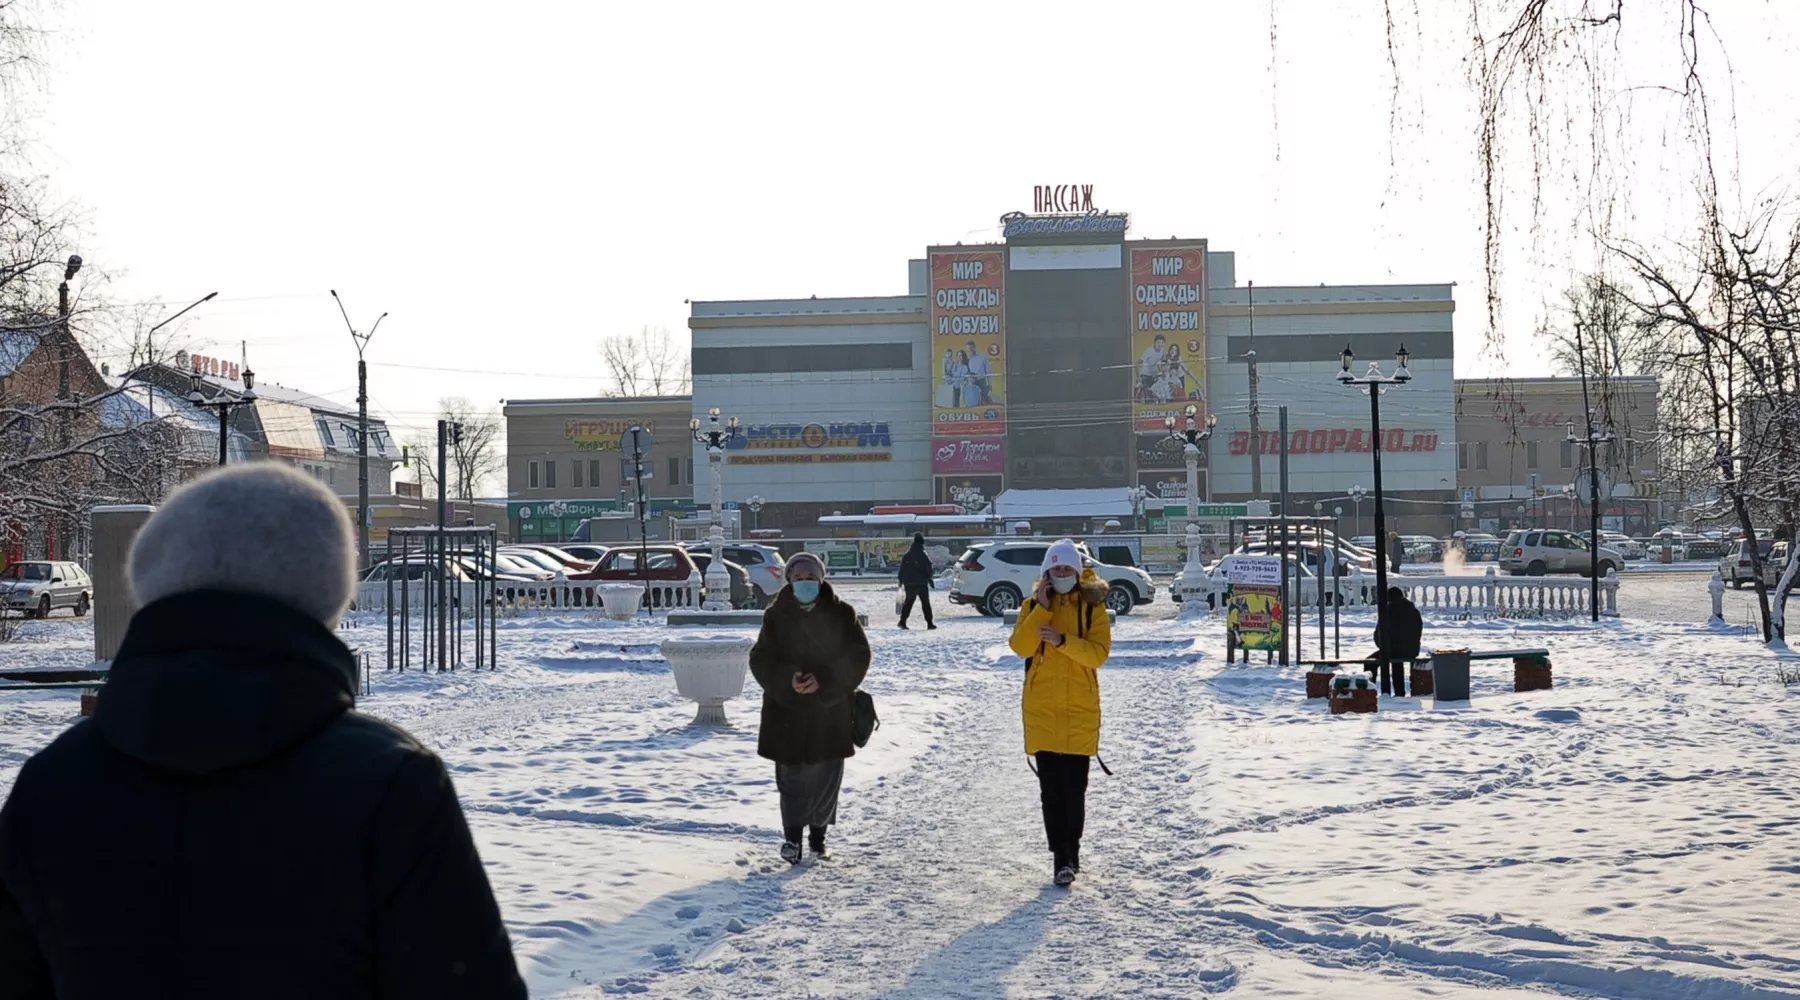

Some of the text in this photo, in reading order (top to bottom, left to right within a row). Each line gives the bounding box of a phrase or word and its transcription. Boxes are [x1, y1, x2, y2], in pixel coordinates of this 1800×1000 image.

[1034, 184, 1093, 212] ПАССАЖ
[1000, 208, 1130, 237] Васильевский
[952, 261, 984, 280] МИР
[1151, 257, 1183, 276] МИР
[936, 288, 1000, 310] ОДЕЖДЫ
[1135, 284, 1200, 306] ОДЕЖДЫ
[938, 315, 999, 335] И ОБУВИ
[1138, 310, 1199, 330] И ОБУВИ
[990, 343, 998, 354] 3
[1189, 340, 1198, 352] 3
[191, 353, 240, 382] ШТОРЫ
[939, 413, 979, 422] ОБУВЬ
[1139, 410, 1181, 418] ОДЕЖДА
